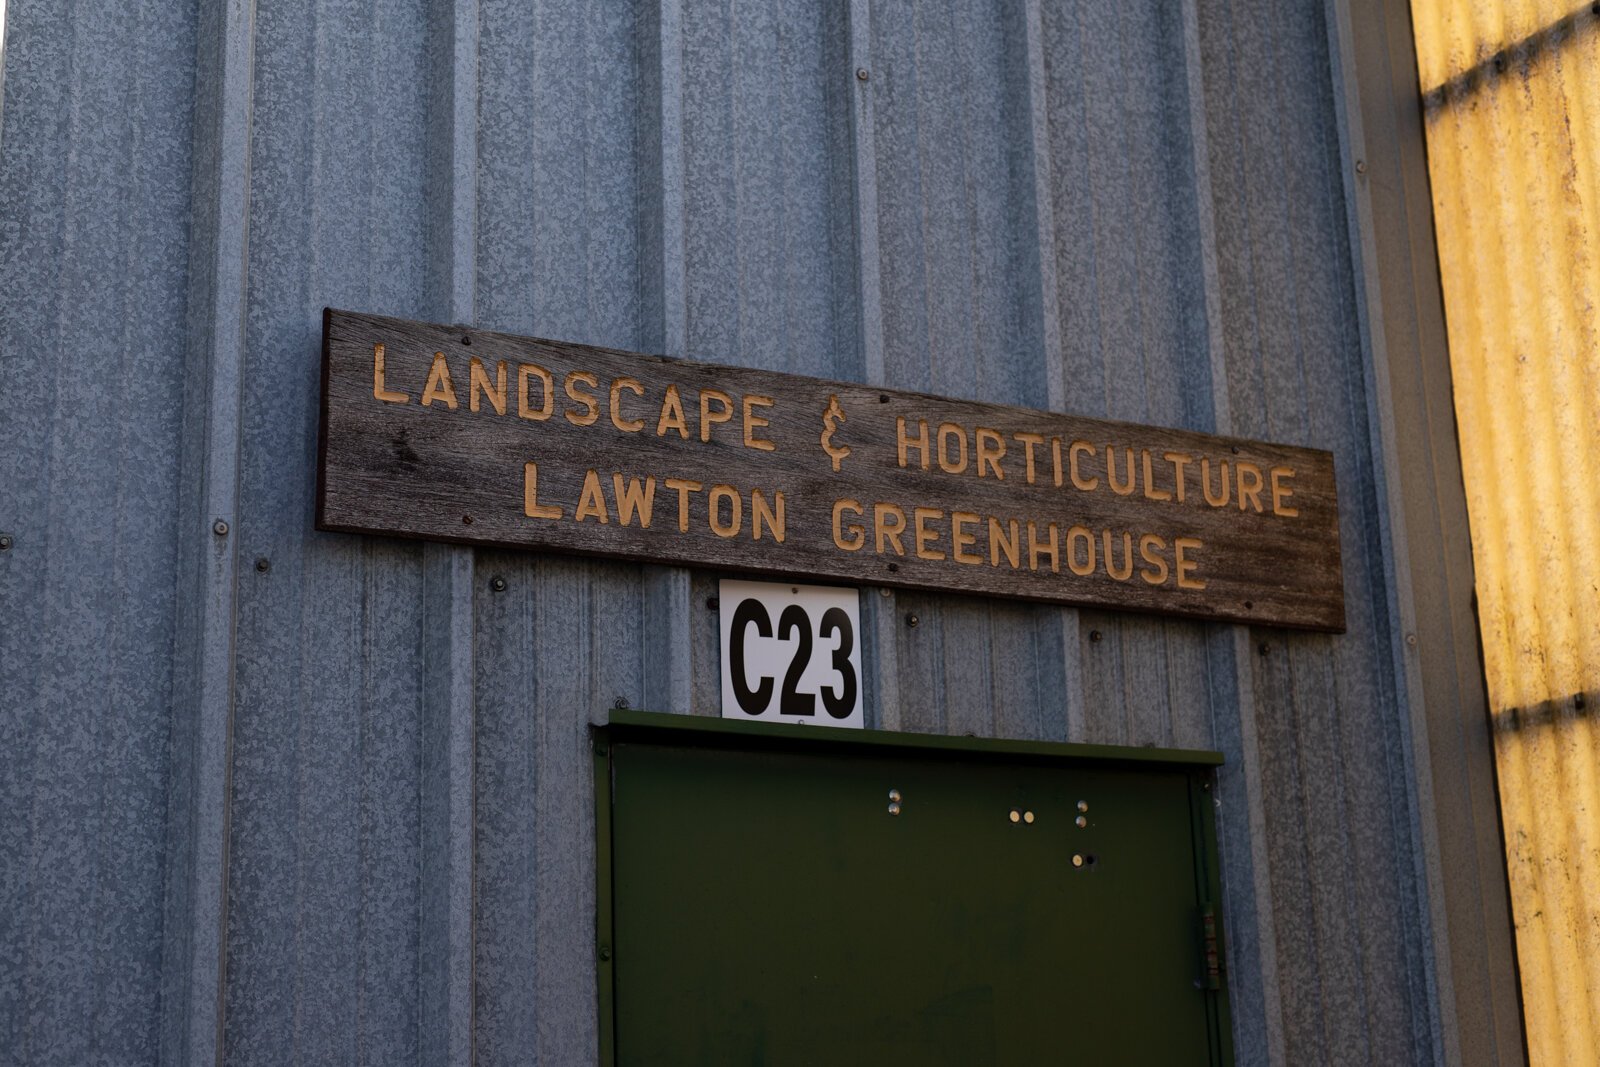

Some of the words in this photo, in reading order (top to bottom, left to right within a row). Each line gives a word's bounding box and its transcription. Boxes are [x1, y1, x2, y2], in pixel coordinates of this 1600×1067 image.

[373, 343, 776, 451] LANDSCAPE
[820, 394, 852, 472] &
[896, 416, 1299, 517] HORTICULTURE
[523, 461, 787, 543] LAWTON
[832, 499, 1206, 590] GREENHOUSE
[729, 598, 857, 719] C23
